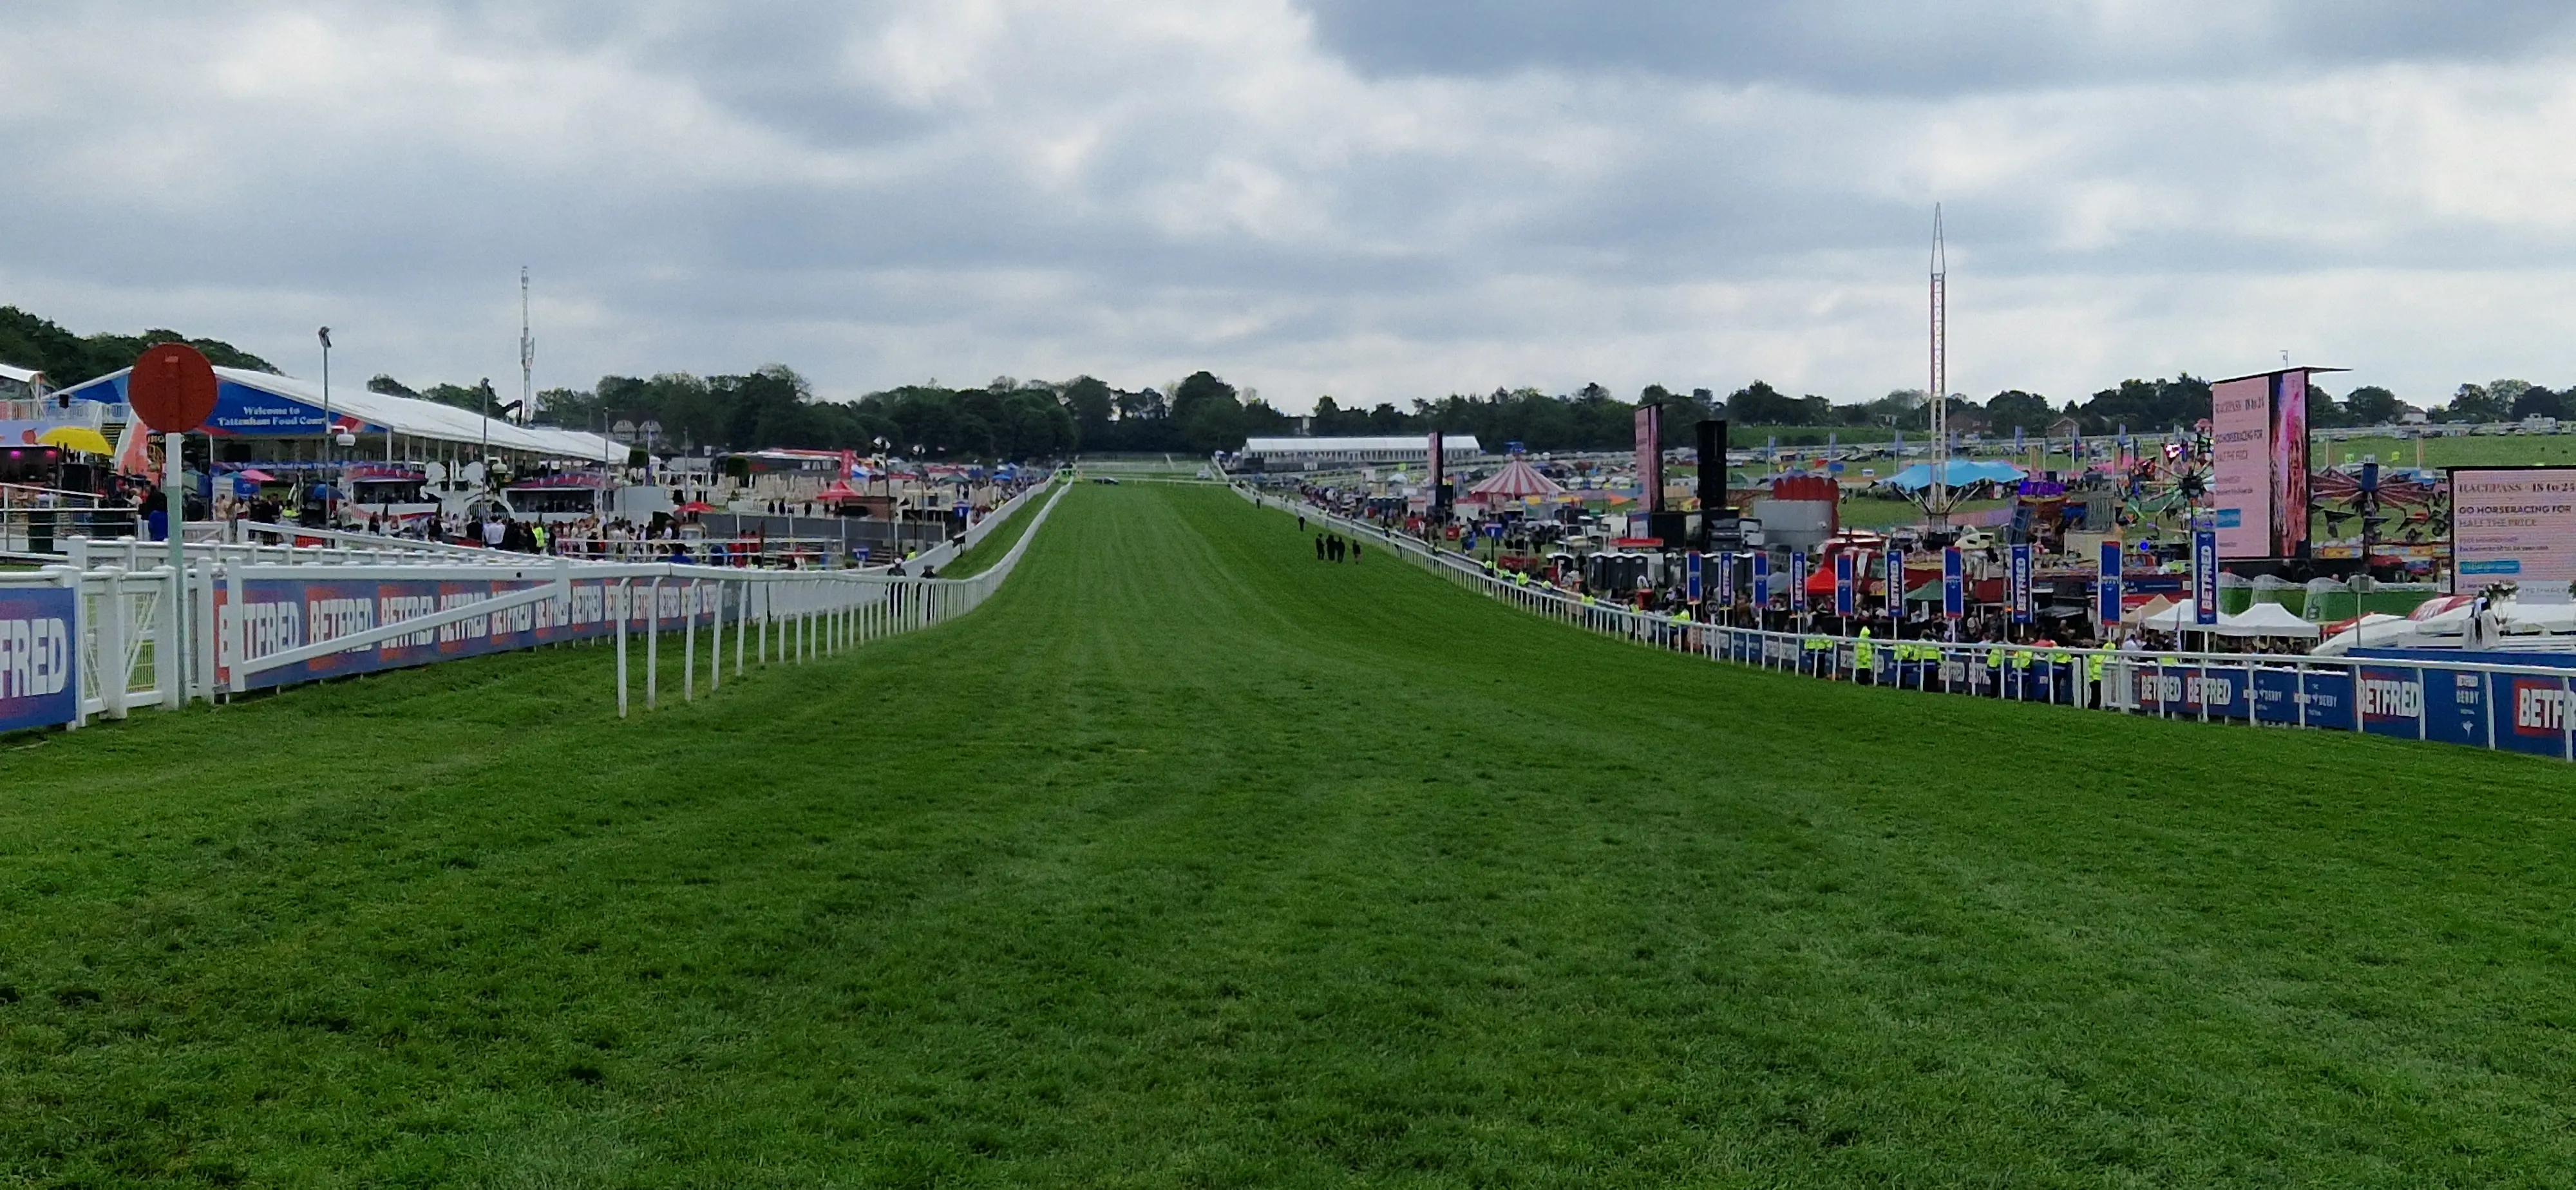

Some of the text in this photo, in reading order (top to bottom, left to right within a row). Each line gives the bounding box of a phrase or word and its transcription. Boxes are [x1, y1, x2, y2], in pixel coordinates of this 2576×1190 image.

[243, 406, 300, 415] Welcome to
[272, 416, 298, 425] Food
[2477, 505, 2550, 514] HORSERACING
[2016, 557, 2027, 611] BETFRED
[2201, 545, 2213, 610] BETFRED
[220, 601, 299, 667] BTFRED
[2355, 679, 2421, 717] BETFRED
